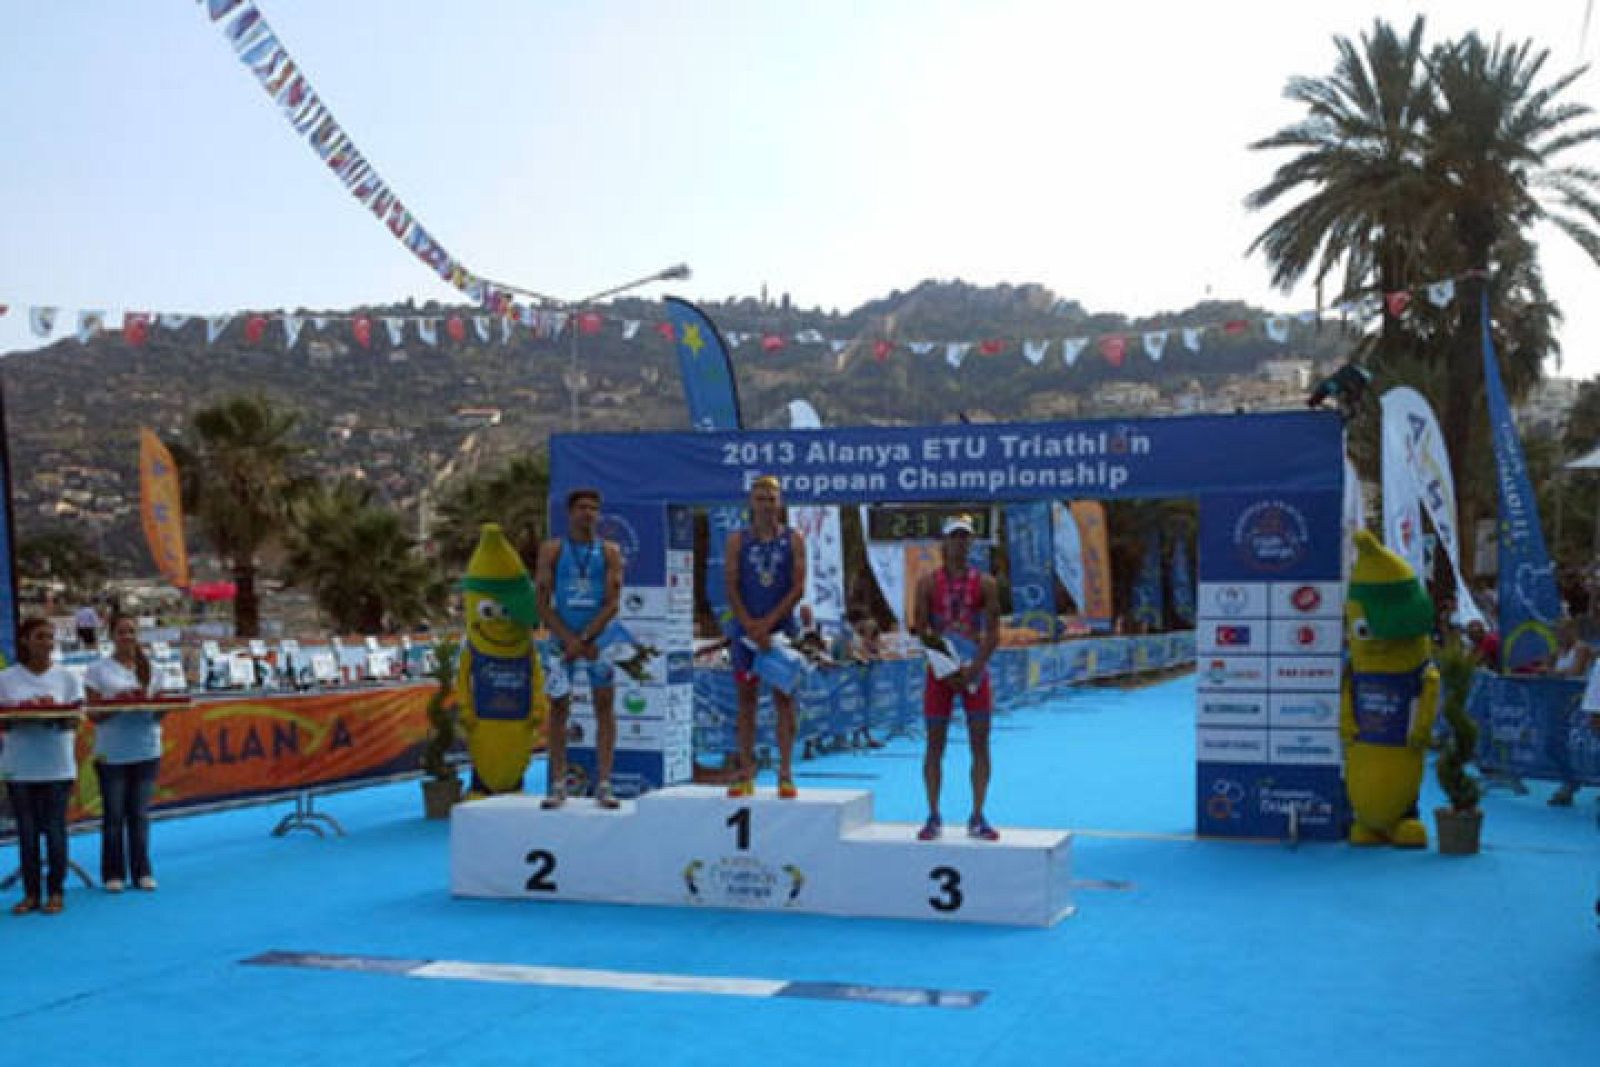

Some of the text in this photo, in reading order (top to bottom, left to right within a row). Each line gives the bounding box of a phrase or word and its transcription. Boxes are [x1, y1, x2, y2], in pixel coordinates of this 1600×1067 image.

[722, 426, 1150, 468] 2013 Alanya ETU Triathlon
[743, 460, 1129, 497] Eropean Championship
[184, 706, 353, 767] ALANYA
[726, 807, 750, 850] 1
[525, 849, 557, 892] 2
[928, 866, 963, 912] 3
